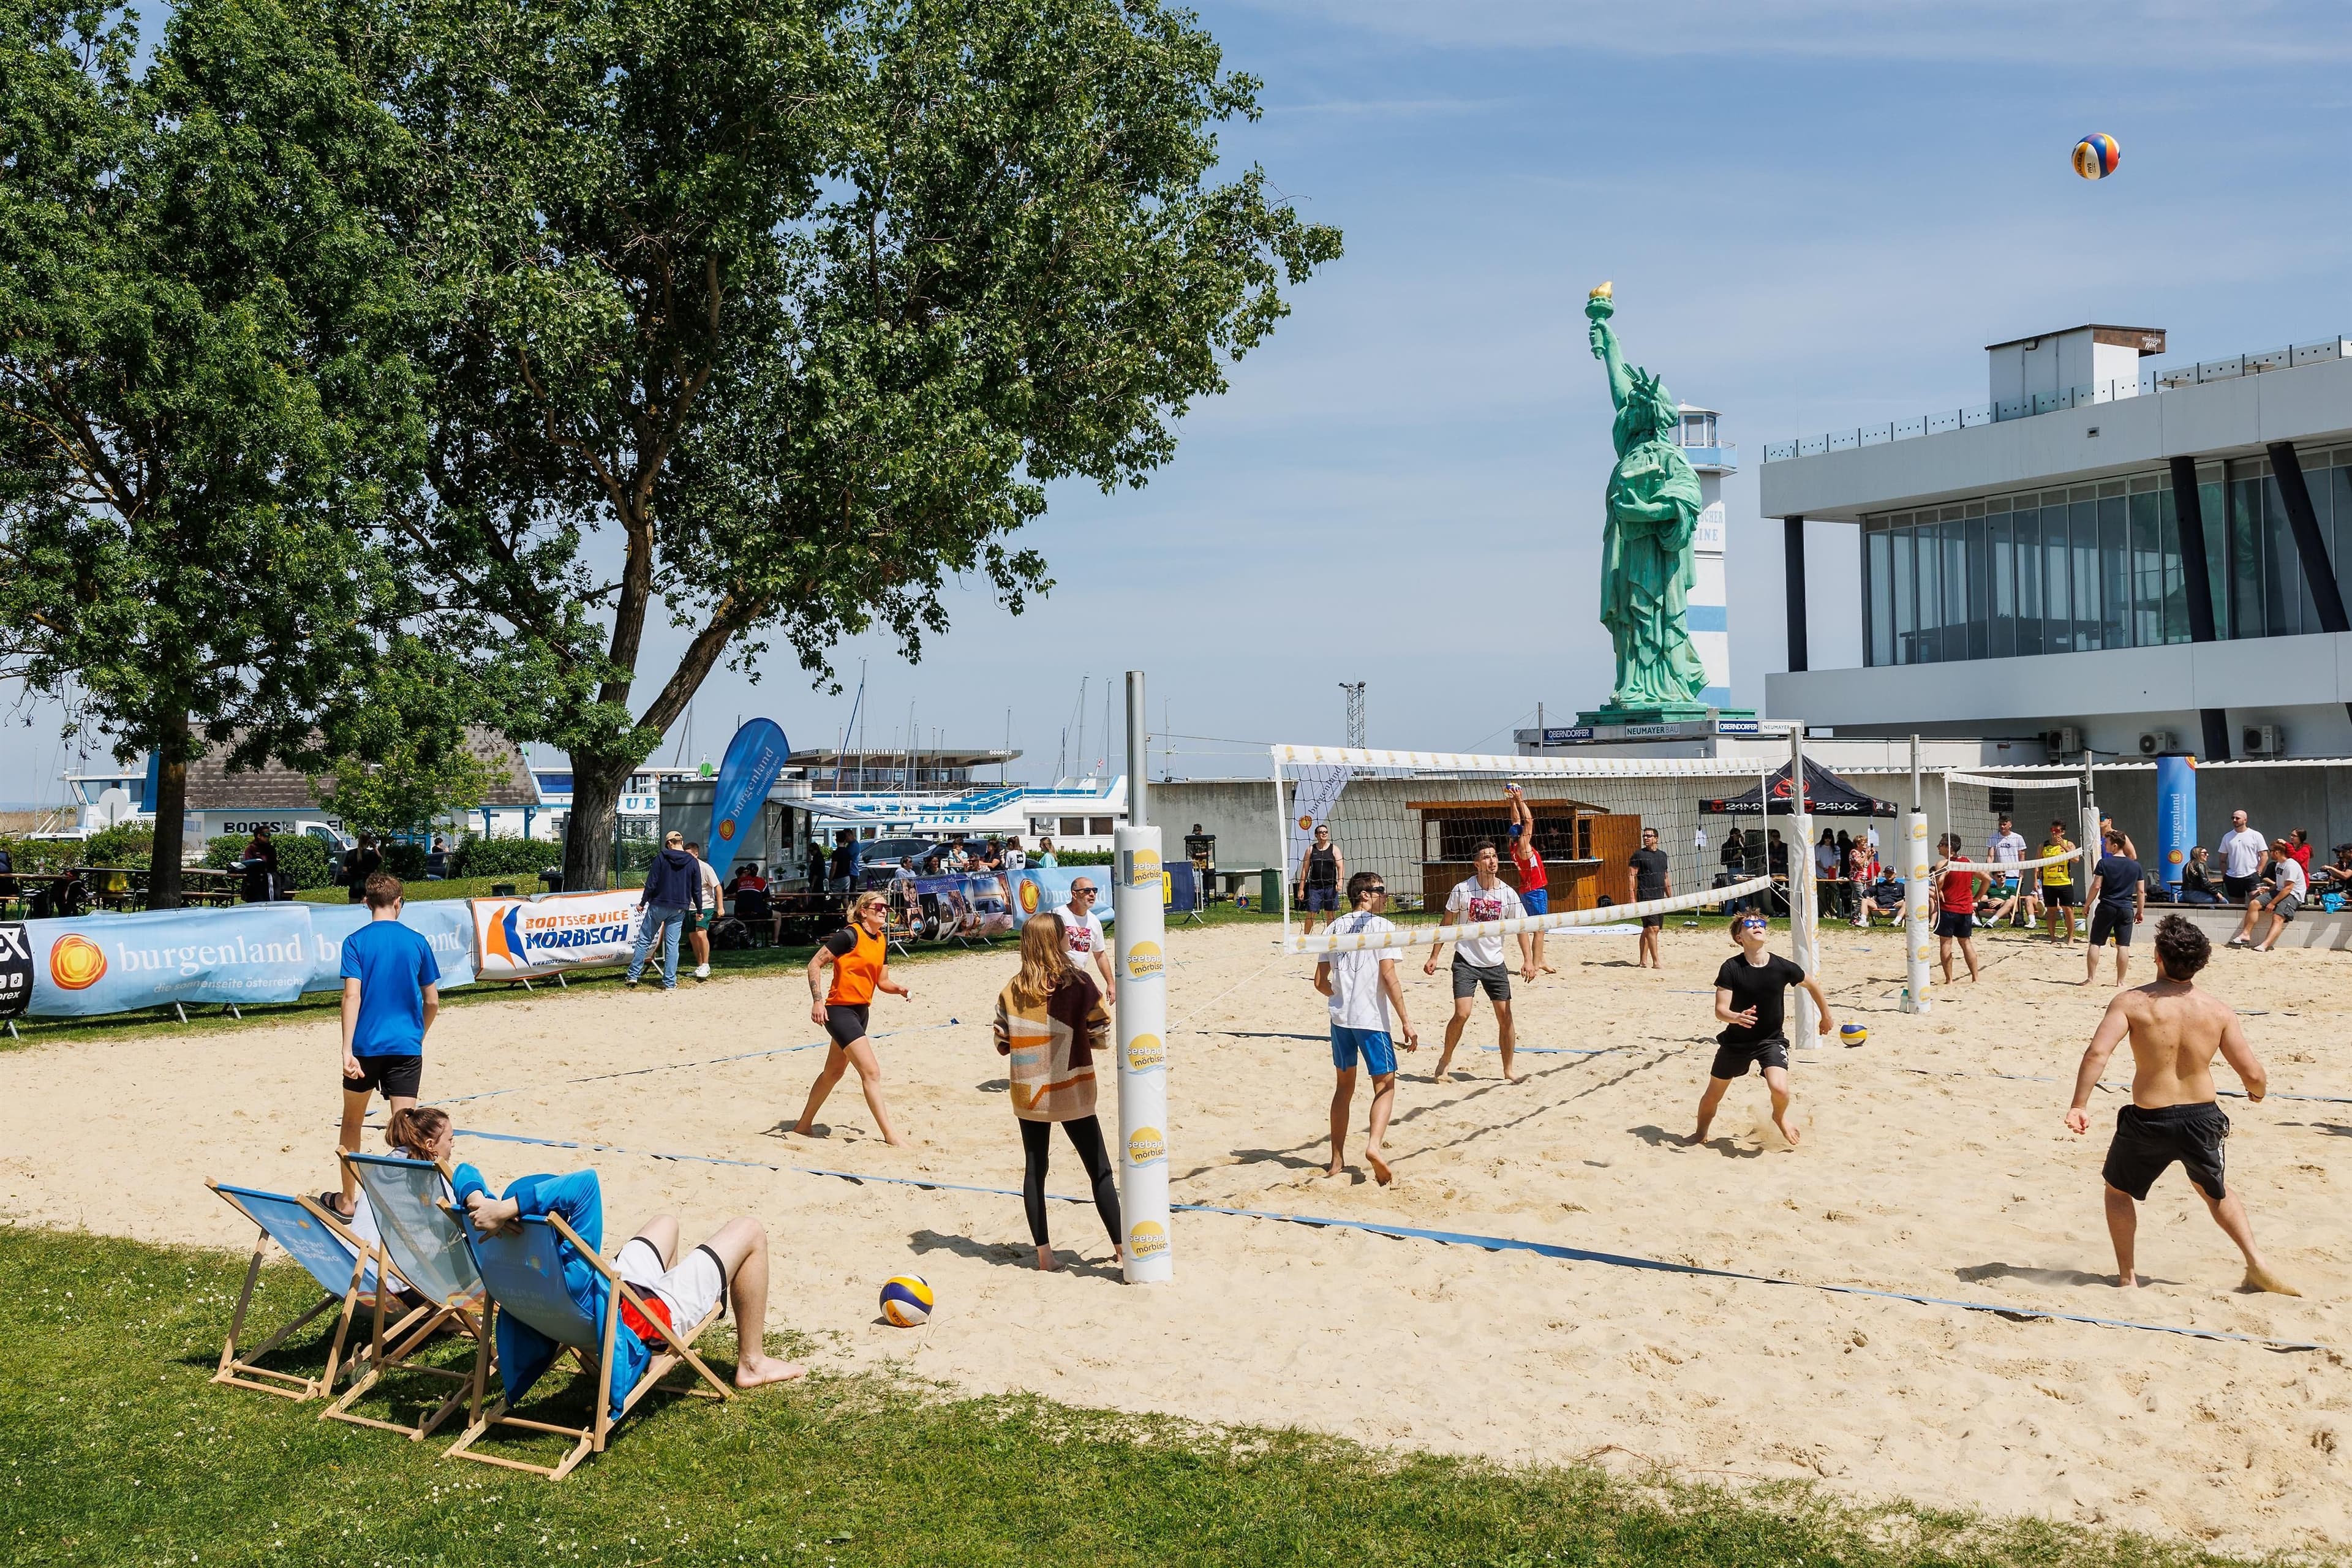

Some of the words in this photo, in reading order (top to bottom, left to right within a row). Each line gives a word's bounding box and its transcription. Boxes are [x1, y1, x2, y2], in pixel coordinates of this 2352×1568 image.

[1548, 729, 1589, 738] OBERNDORFER
[1627, 726, 1664, 735] NEUMAYER
[1665, 725, 1679, 734] BAU
[731, 747, 774, 818] burgenland
[2171, 794, 2182, 846] burgenland
[117, 933, 304, 976] burgenland
[154, 982, 172, 993] die
[174, 978, 243, 989] sonnenseite
[246, 974, 305, 989] österreichs
[1129, 1234, 1166, 1243] seebad
